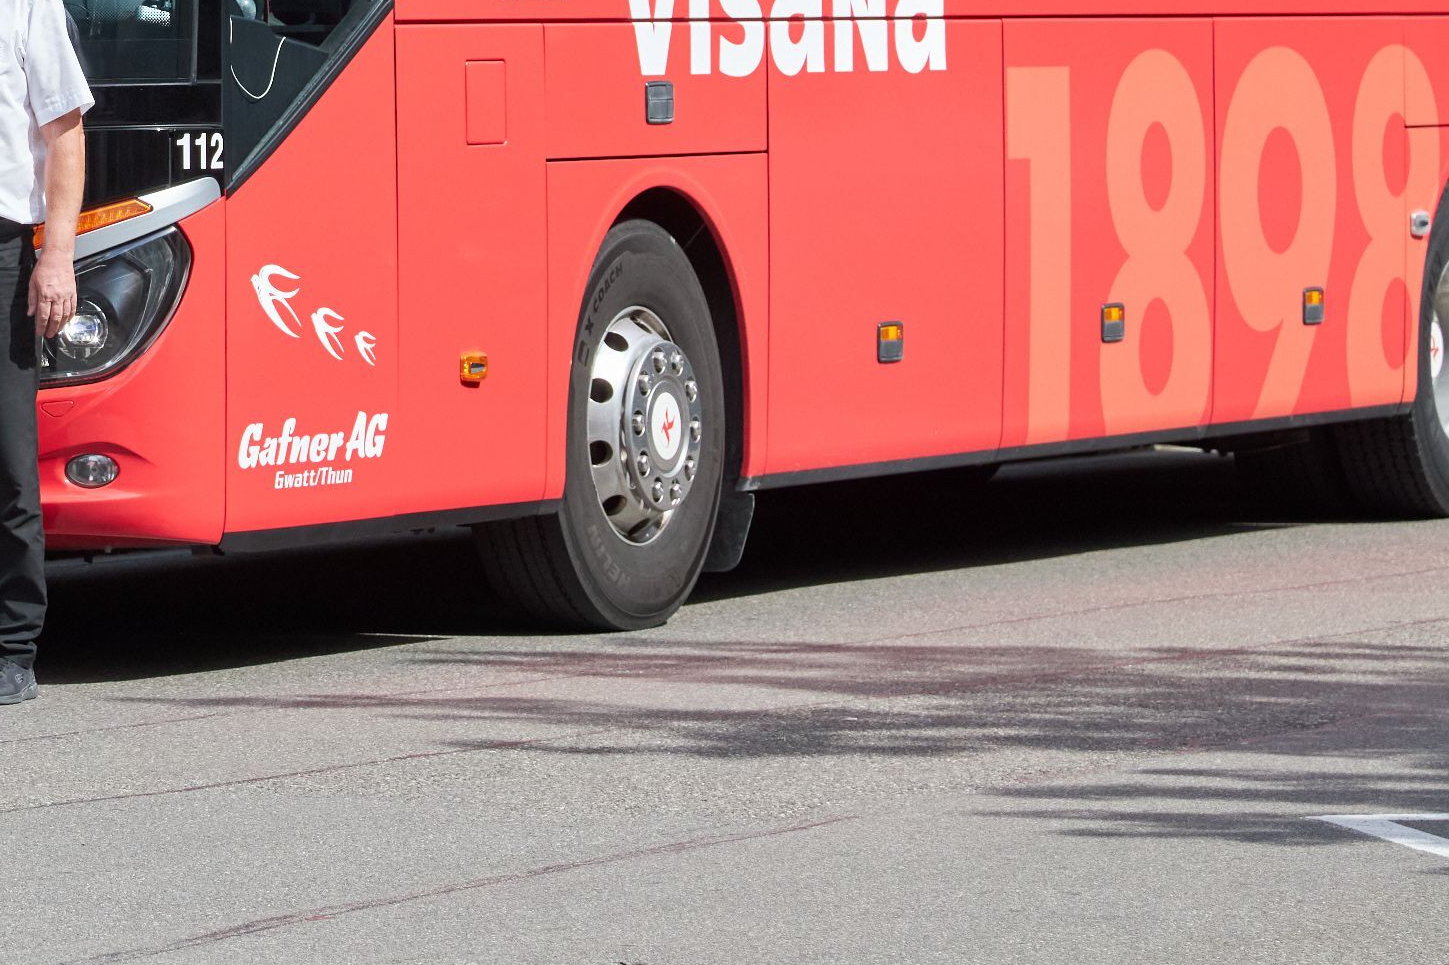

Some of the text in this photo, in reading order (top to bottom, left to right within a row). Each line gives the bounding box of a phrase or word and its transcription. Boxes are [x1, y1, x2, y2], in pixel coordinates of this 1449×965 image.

[176, 132, 224, 170] 112
[1006, 42, 1442, 444] 1898
[593, 261, 624, 313] COACH
[238, 410, 389, 470] Gafner AG
[274, 467, 353, 490] Gwatt/Thun
